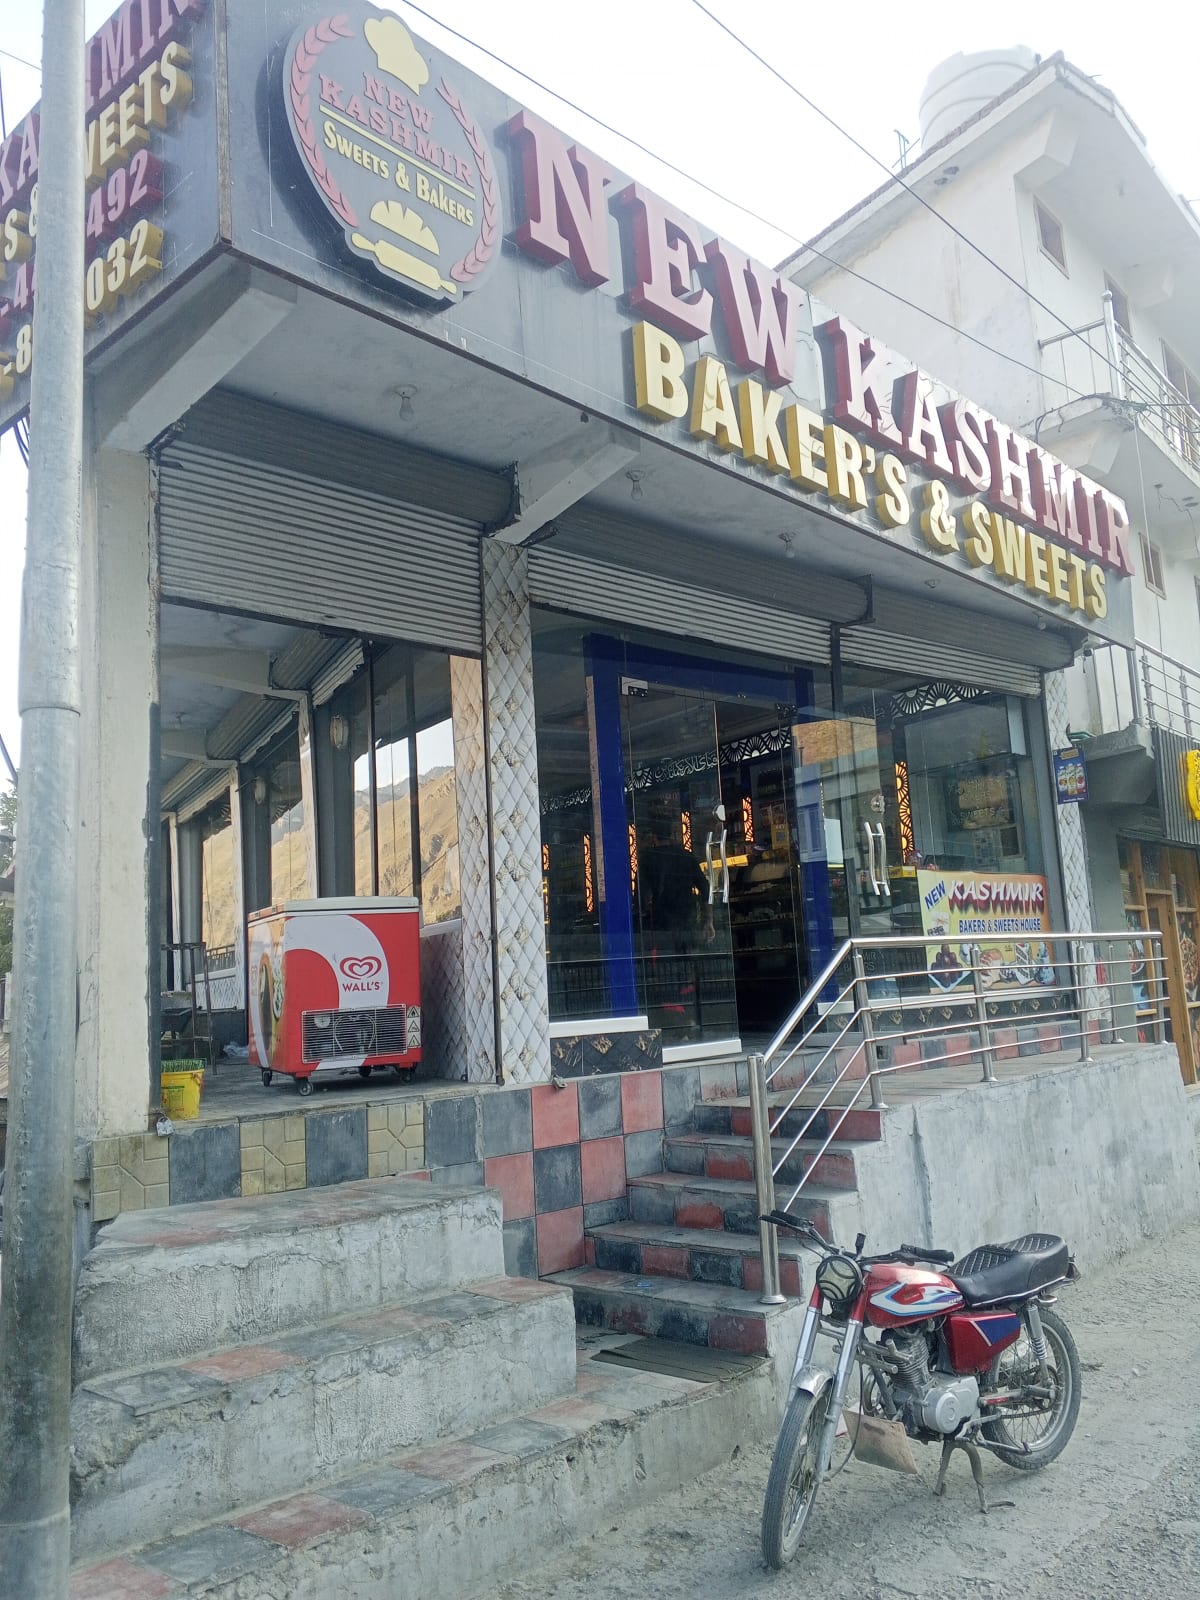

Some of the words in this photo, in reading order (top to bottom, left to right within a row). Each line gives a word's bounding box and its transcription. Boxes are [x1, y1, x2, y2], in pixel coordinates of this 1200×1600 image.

[319, 74, 475, 188] KASHMIR
[363, 72, 434, 134] NEW
[395, 162, 411, 193] &
[510, 110, 794, 386] NEW
[829, 317, 1133, 578] KASHMIR
[921, 480, 960, 552] &
[964, 501, 1108, 619] SWEETS
[924, 880, 947, 910] NEW
[949, 880, 1044, 907] KASHMIR
[959, 919, 986, 933] BAKERS
[994, 919, 1019, 932] SWEETS
[1020, 918, 1041, 931] HOUSE
